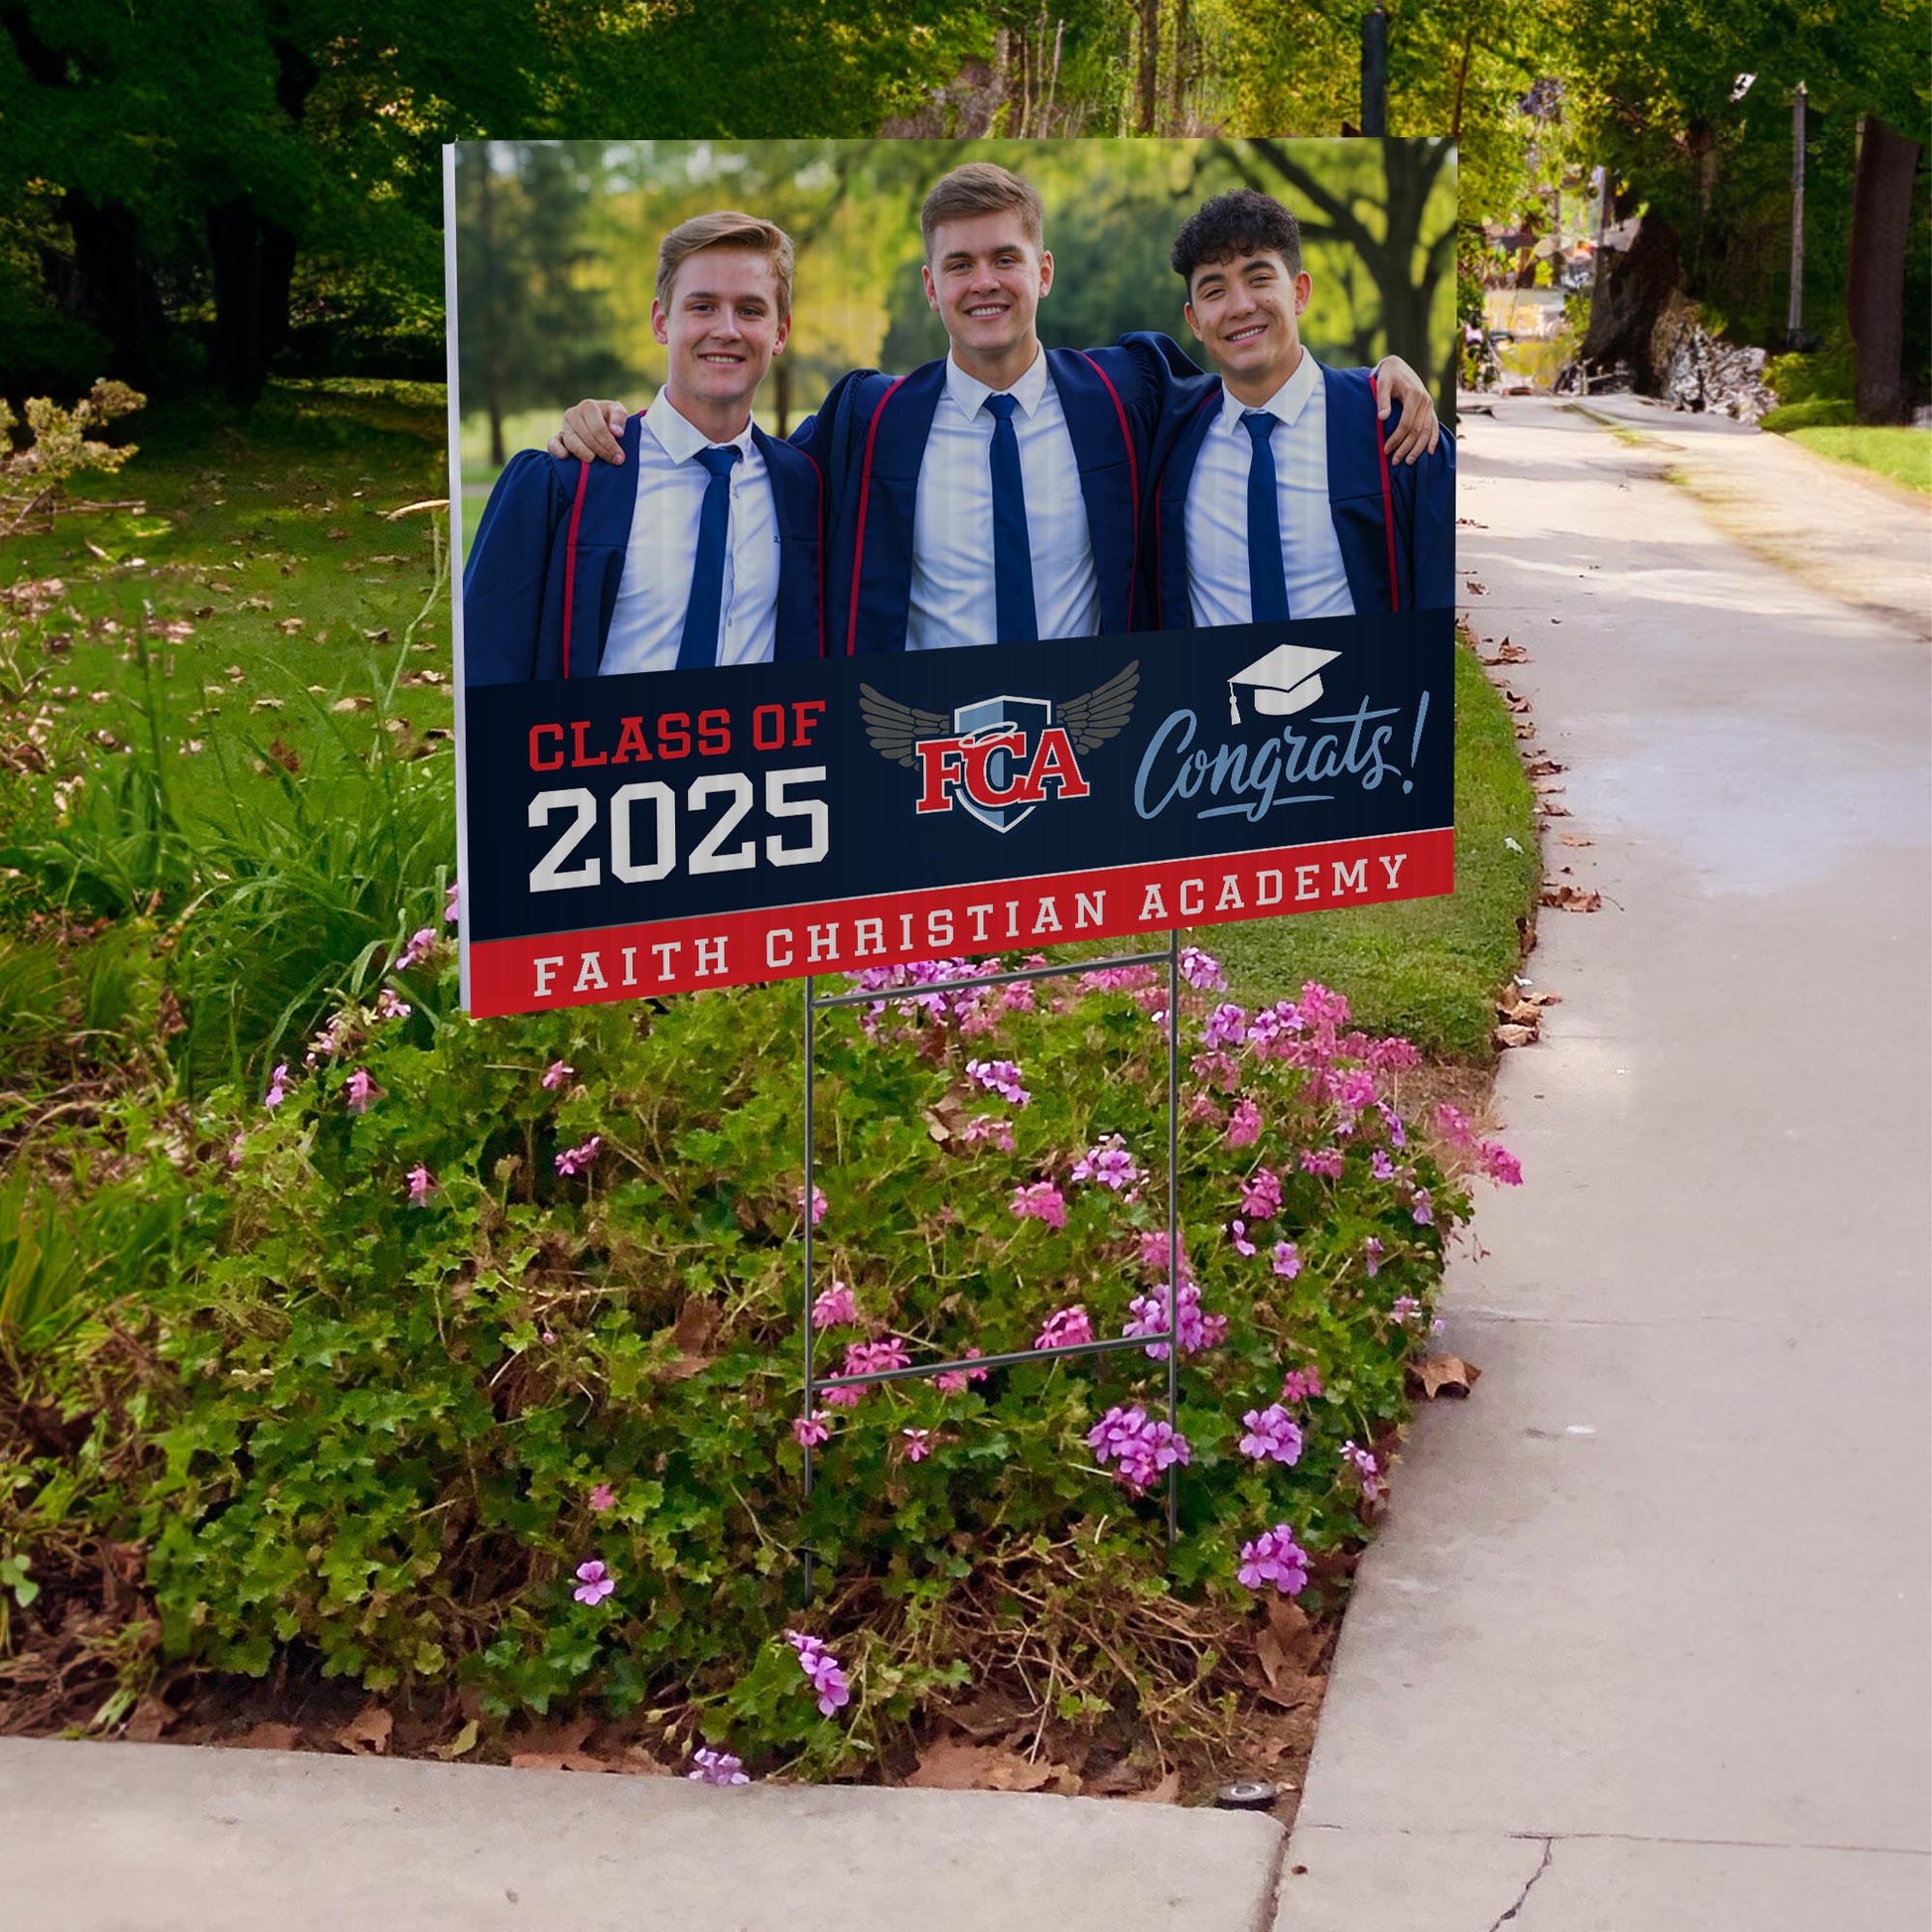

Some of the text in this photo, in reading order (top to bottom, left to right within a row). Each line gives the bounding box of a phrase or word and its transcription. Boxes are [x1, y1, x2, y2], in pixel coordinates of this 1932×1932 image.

[528, 700, 826, 772] CLASS OF
[915, 727, 1090, 814] FCA
[1134, 691, 1430, 822] Congrats!
[528, 765, 829, 893] 2025
[533, 854, 1408, 997] FAITH CHRISTIAN ACADEMY
